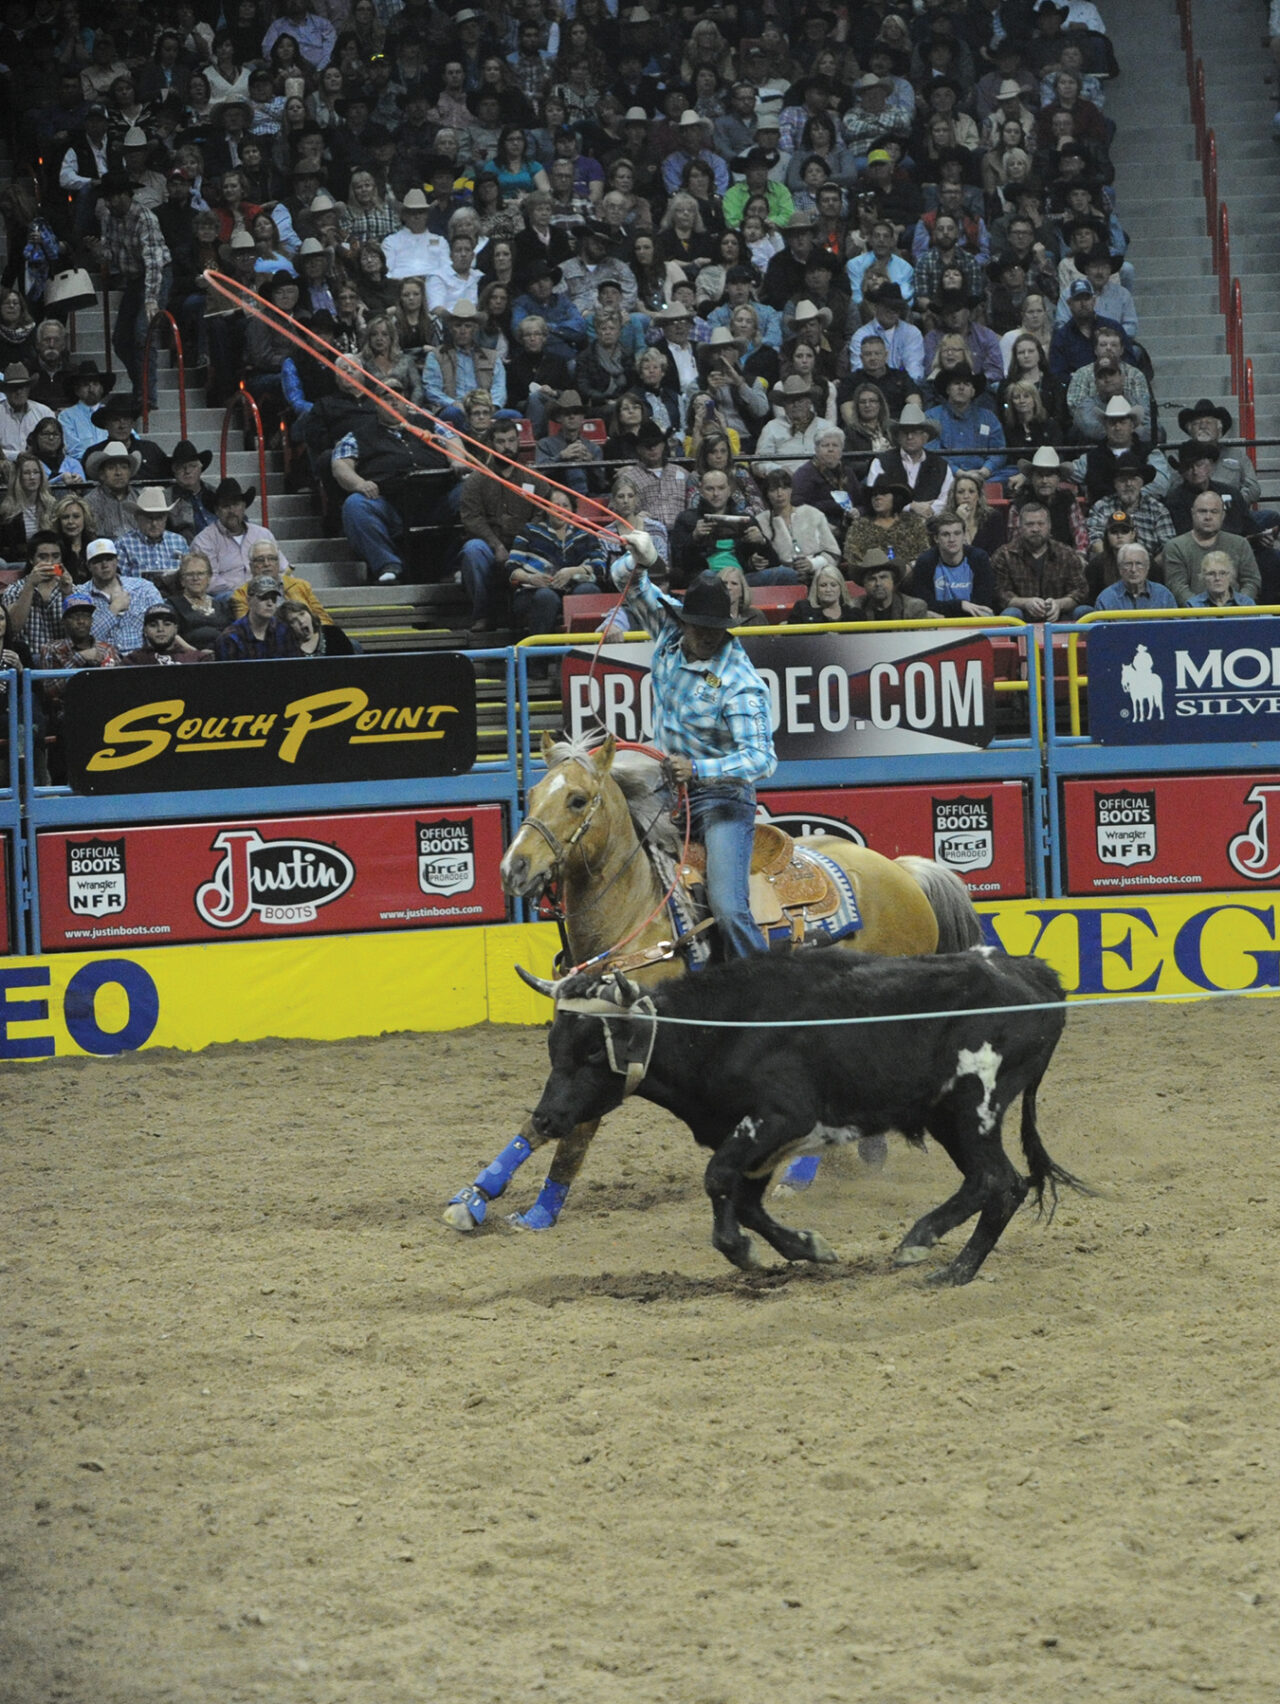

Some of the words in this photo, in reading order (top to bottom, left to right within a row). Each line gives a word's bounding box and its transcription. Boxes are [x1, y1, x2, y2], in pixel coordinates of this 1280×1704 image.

[936, 804, 988, 816] OFFICIAL
[1099, 798, 1150, 810] OFFICIAL
[936, 815, 988, 830] BOOTS
[1100, 808, 1151, 824] BOOTS
[420, 826, 469, 840] OFFICIAL
[1105, 830, 1147, 842] Wrangler
[71, 847, 120, 859] OFFICIAL
[420, 838, 470, 854] BOOTS
[1101, 843, 1152, 858] NFR
[945, 850, 987, 859] PRORODEO
[71, 858, 121, 874] BOOTS
[196, 830, 340, 927] Justin
[429, 872, 469, 882] PRORODEO
[1093, 874, 1202, 888] www.justinboots.com
[77, 880, 118, 893] Wrangler
[73, 893, 122, 910] NFR
[264, 906, 313, 920] BOOTS
[380, 905, 483, 920] www.justinboots.com
[65, 924, 171, 939] www.justinboots.com
